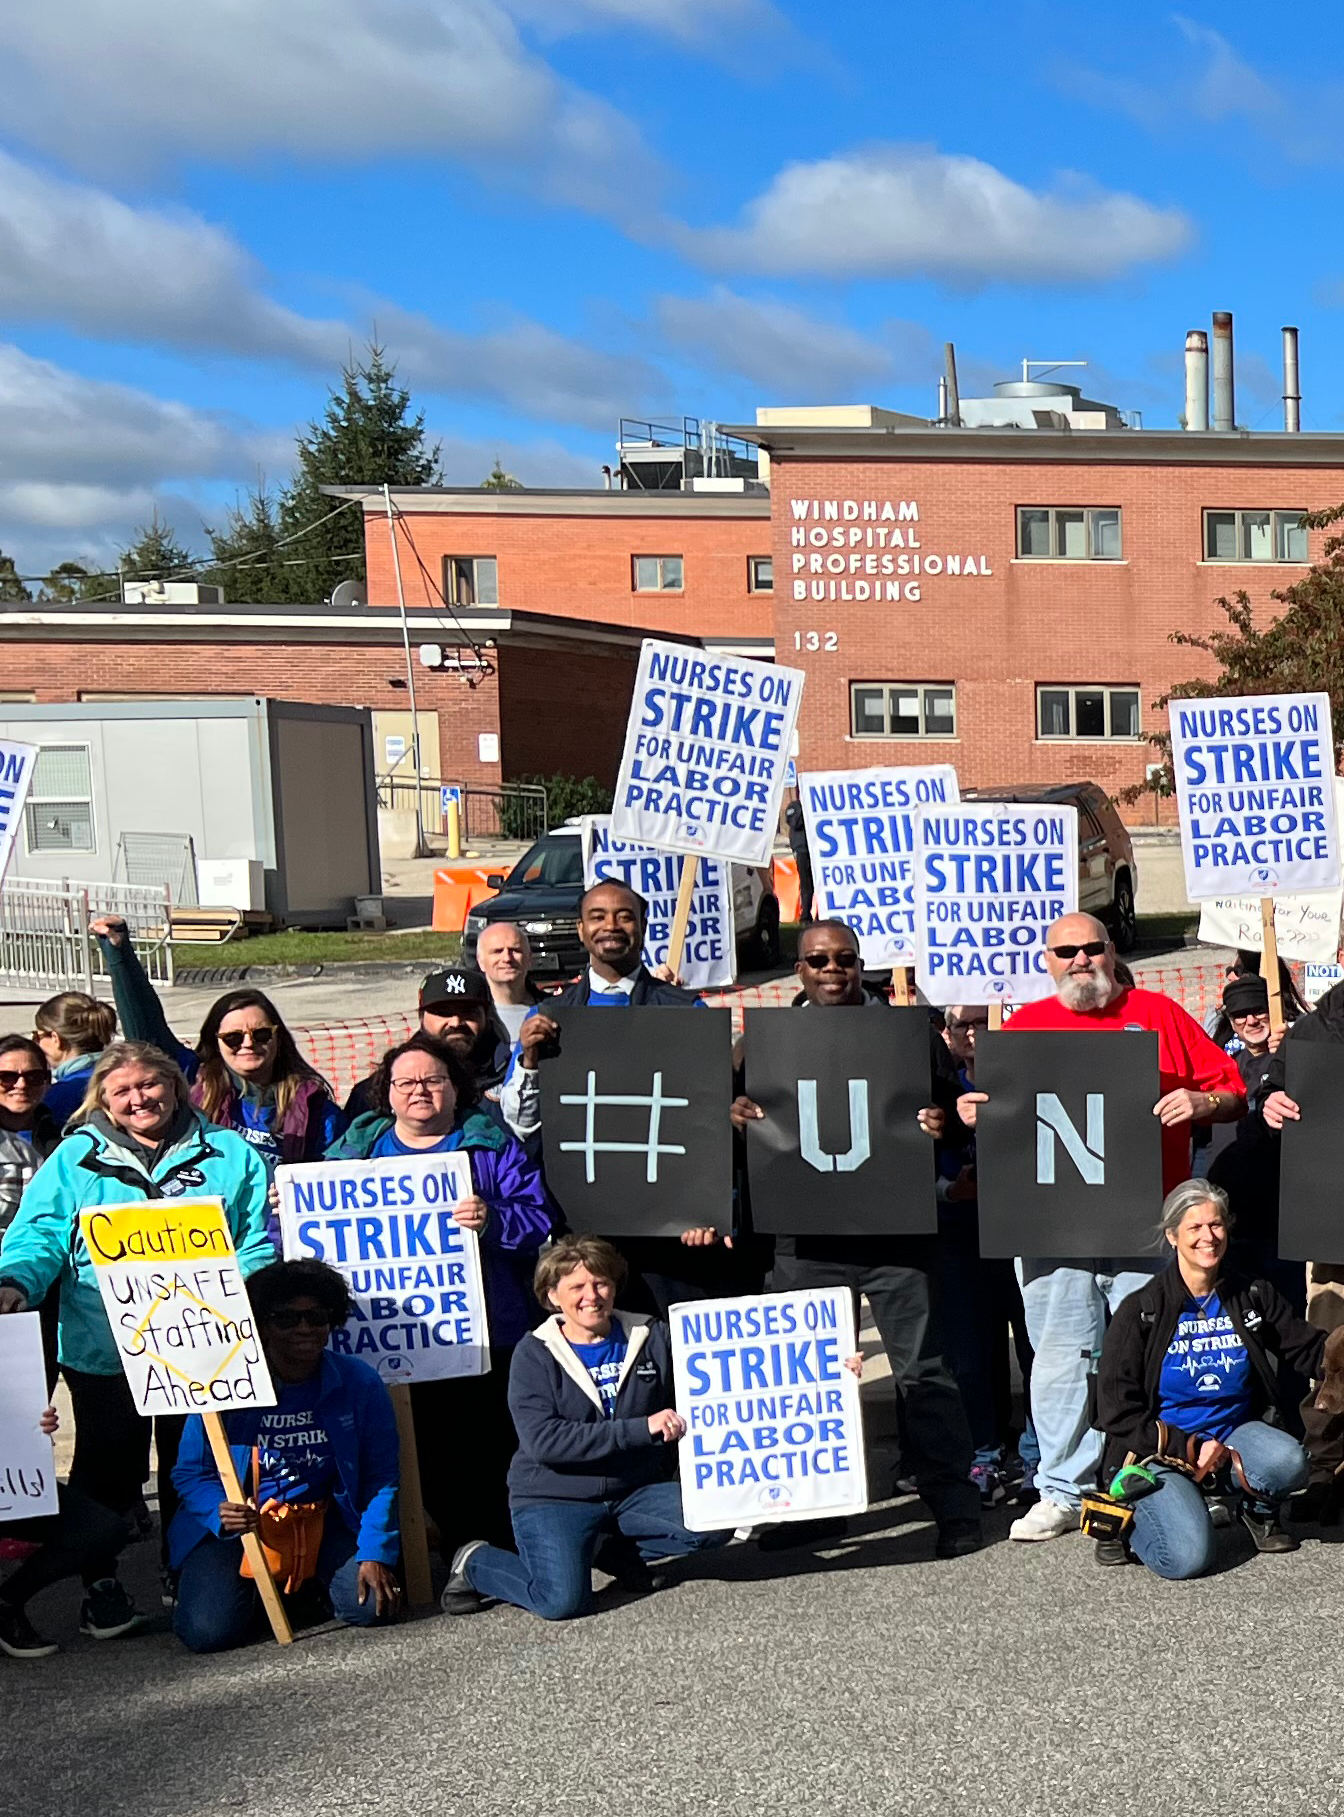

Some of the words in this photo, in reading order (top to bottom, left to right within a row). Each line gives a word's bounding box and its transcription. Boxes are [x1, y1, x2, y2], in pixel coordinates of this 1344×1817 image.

[791, 500, 919, 521] WINDHAM
[791, 526, 921, 548] HOSPITAL
[792, 553, 993, 575] PROFESSIONAL
[793, 579, 921, 601] BUILDING
[794, 631, 838, 651] 132
[648, 652, 754, 699] NURSES
[759, 676, 791, 707] ON
[641, 688, 784, 751] STRIKE
[1179, 706, 1281, 739] NURSES
[1288, 704, 1318, 733] ON
[635, 734, 671, 760] FOR
[677, 742, 774, 780] UNFAIR
[1183, 739, 1322, 785] STRIKE
[631, 760, 769, 805] LABOR
[809, 780, 910, 813] NURSES
[915, 778, 946, 803] ON
[1188, 793, 1223, 814] FOR
[1228, 785, 1324, 812] UNFAIR
[625, 784, 767, 833] PRACTICE
[1191, 811, 1325, 839] LABOR
[815, 814, 914, 858] STRI
[922, 818, 1026, 846] NURSES
[1033, 818, 1064, 846] ON
[1194, 835, 1329, 868] PRACTICE
[822, 865, 855, 886] FOR
[860, 860, 911, 883] UNF
[925, 853, 1065, 893] STRIKE
[825, 886, 914, 910] LAB
[926, 901, 961, 922] FOR
[927, 926, 1047, 948] LABO
[928, 951, 1048, 976] PRACTIC
[446, 974, 465, 993] NY
[797, 1078, 870, 1172] U
[1035, 1092, 1105, 1186] N
[293, 1174, 415, 1213] NURSES
[422, 1171, 458, 1203] ON
[89, 1212, 229, 1261] Caution
[299, 1211, 464, 1262] STRIKE
[109, 1268, 239, 1304] UNSAFE
[351, 1262, 466, 1293] UNFAIR
[345, 1291, 469, 1322] ABOR
[682, 1303, 796, 1344] NURSES
[803, 1299, 837, 1331] ON
[120, 1308, 259, 1364] Staffing
[330, 1318, 473, 1355] RACTICE
[1178, 1316, 1234, 1336] NURSES
[1167, 1339, 1190, 1355] ON
[686, 1338, 841, 1396] STRIKE
[143, 1363, 257, 1407] Ahead
[260, 1410, 314, 1428] NURSE
[690, 1404, 729, 1429] FOR
[735, 1389, 844, 1423] UNFAIR
[273, 1430, 329, 1448] STRIK
[693, 1418, 846, 1457] LABOR
[695, 1446, 850, 1489] PRACTICE
